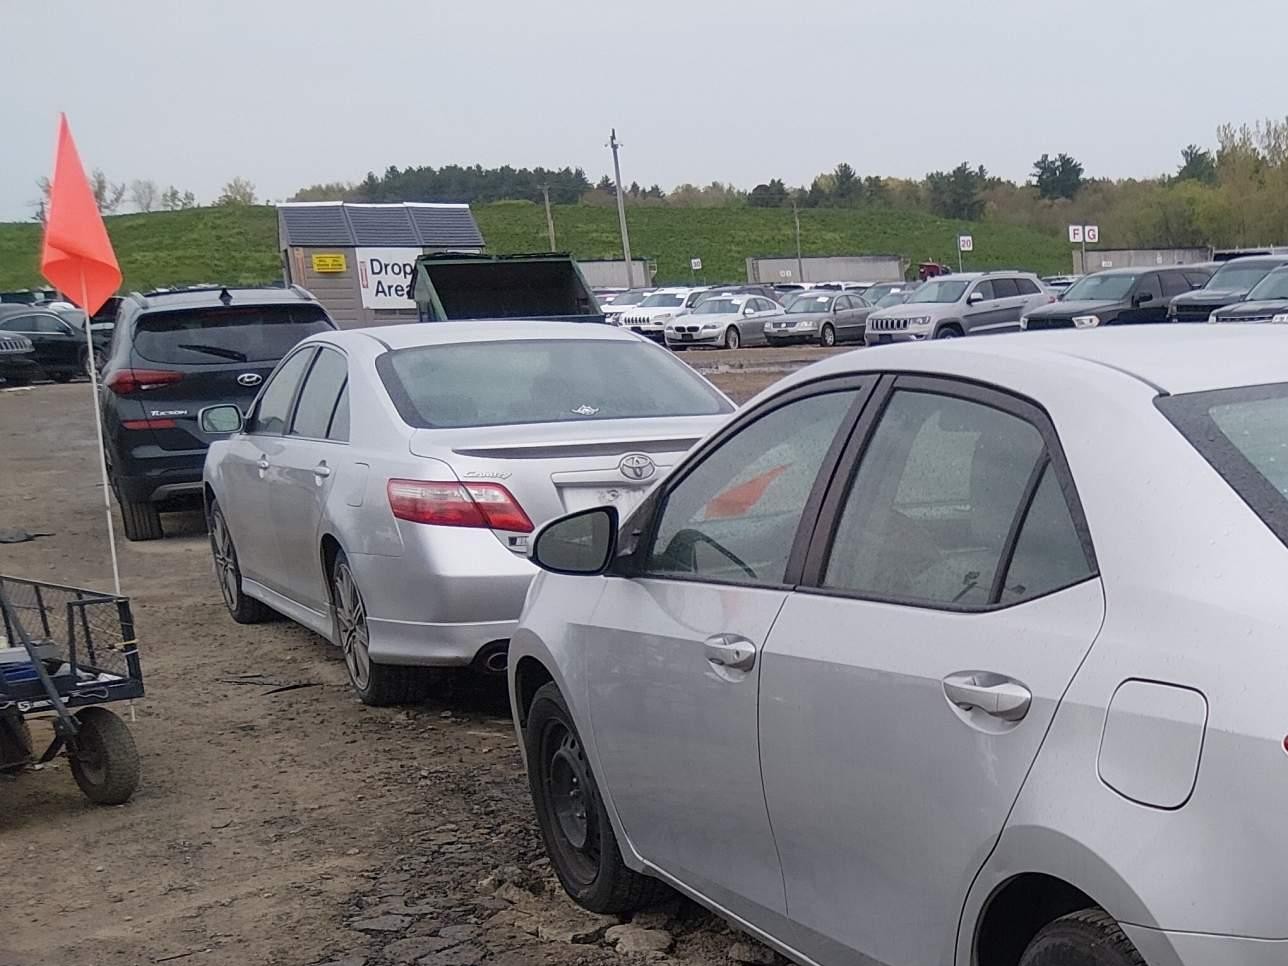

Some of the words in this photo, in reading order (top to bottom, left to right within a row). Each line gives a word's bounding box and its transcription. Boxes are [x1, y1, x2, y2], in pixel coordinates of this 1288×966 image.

[1073, 229, 1079, 240] F
[1088, 229, 1096, 240] G
[370, 258, 413, 279] Drop
